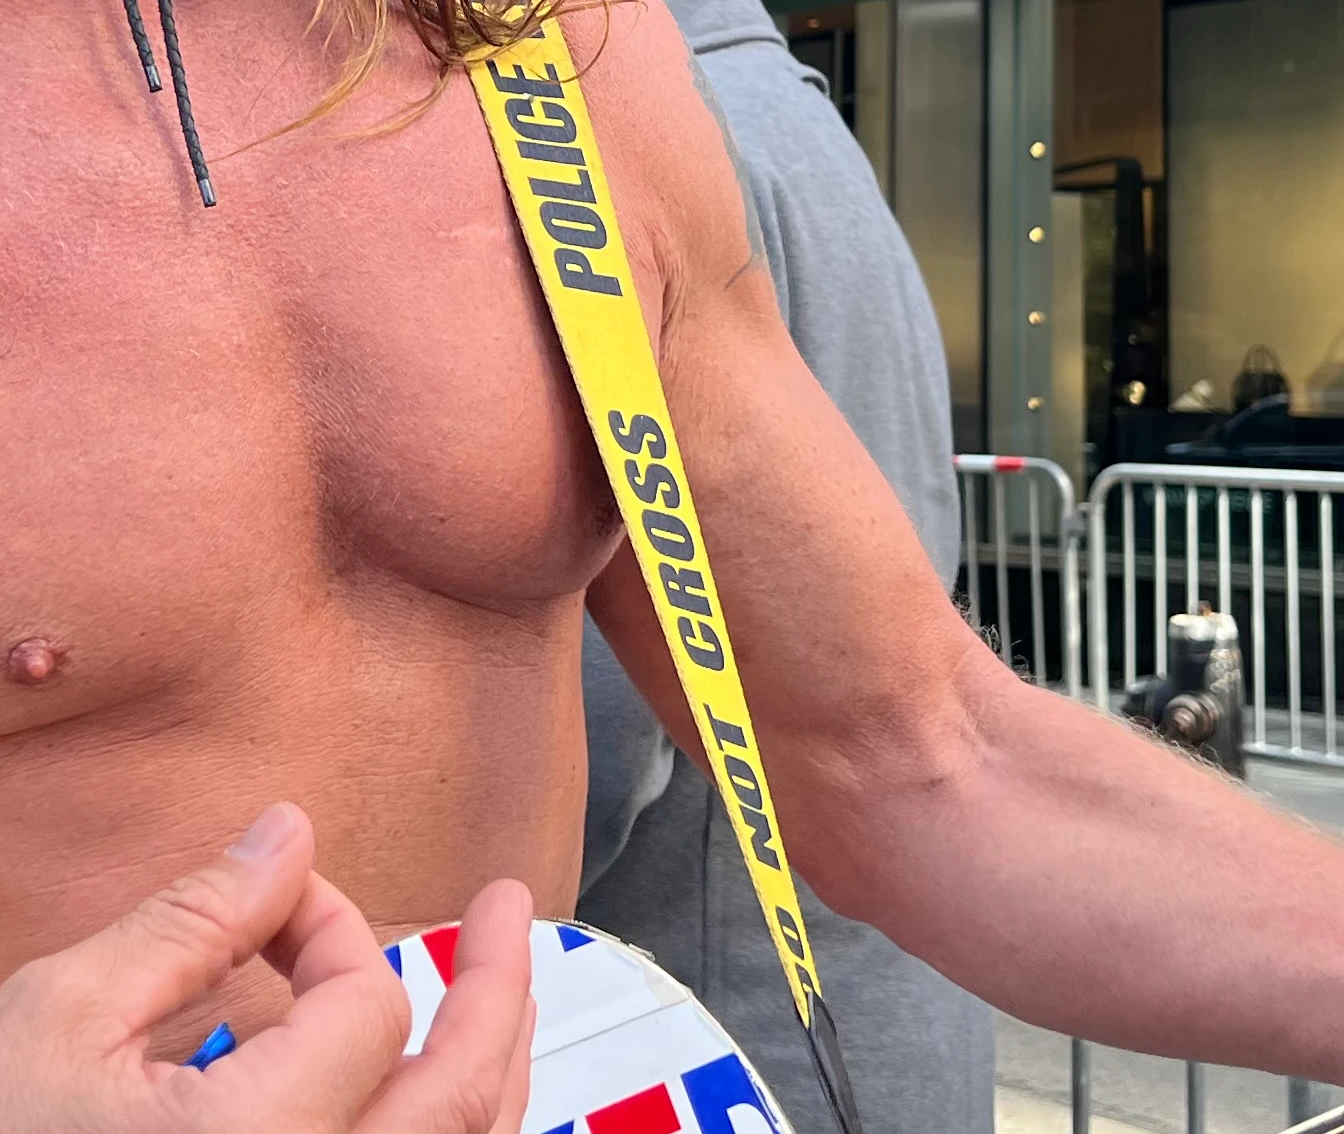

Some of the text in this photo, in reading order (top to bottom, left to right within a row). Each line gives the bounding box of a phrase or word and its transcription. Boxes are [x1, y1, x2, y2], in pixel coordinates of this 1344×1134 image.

[486, 58, 624, 297] POLICE
[608, 409, 725, 673] CROSS
[703, 703, 782, 873] NOT
